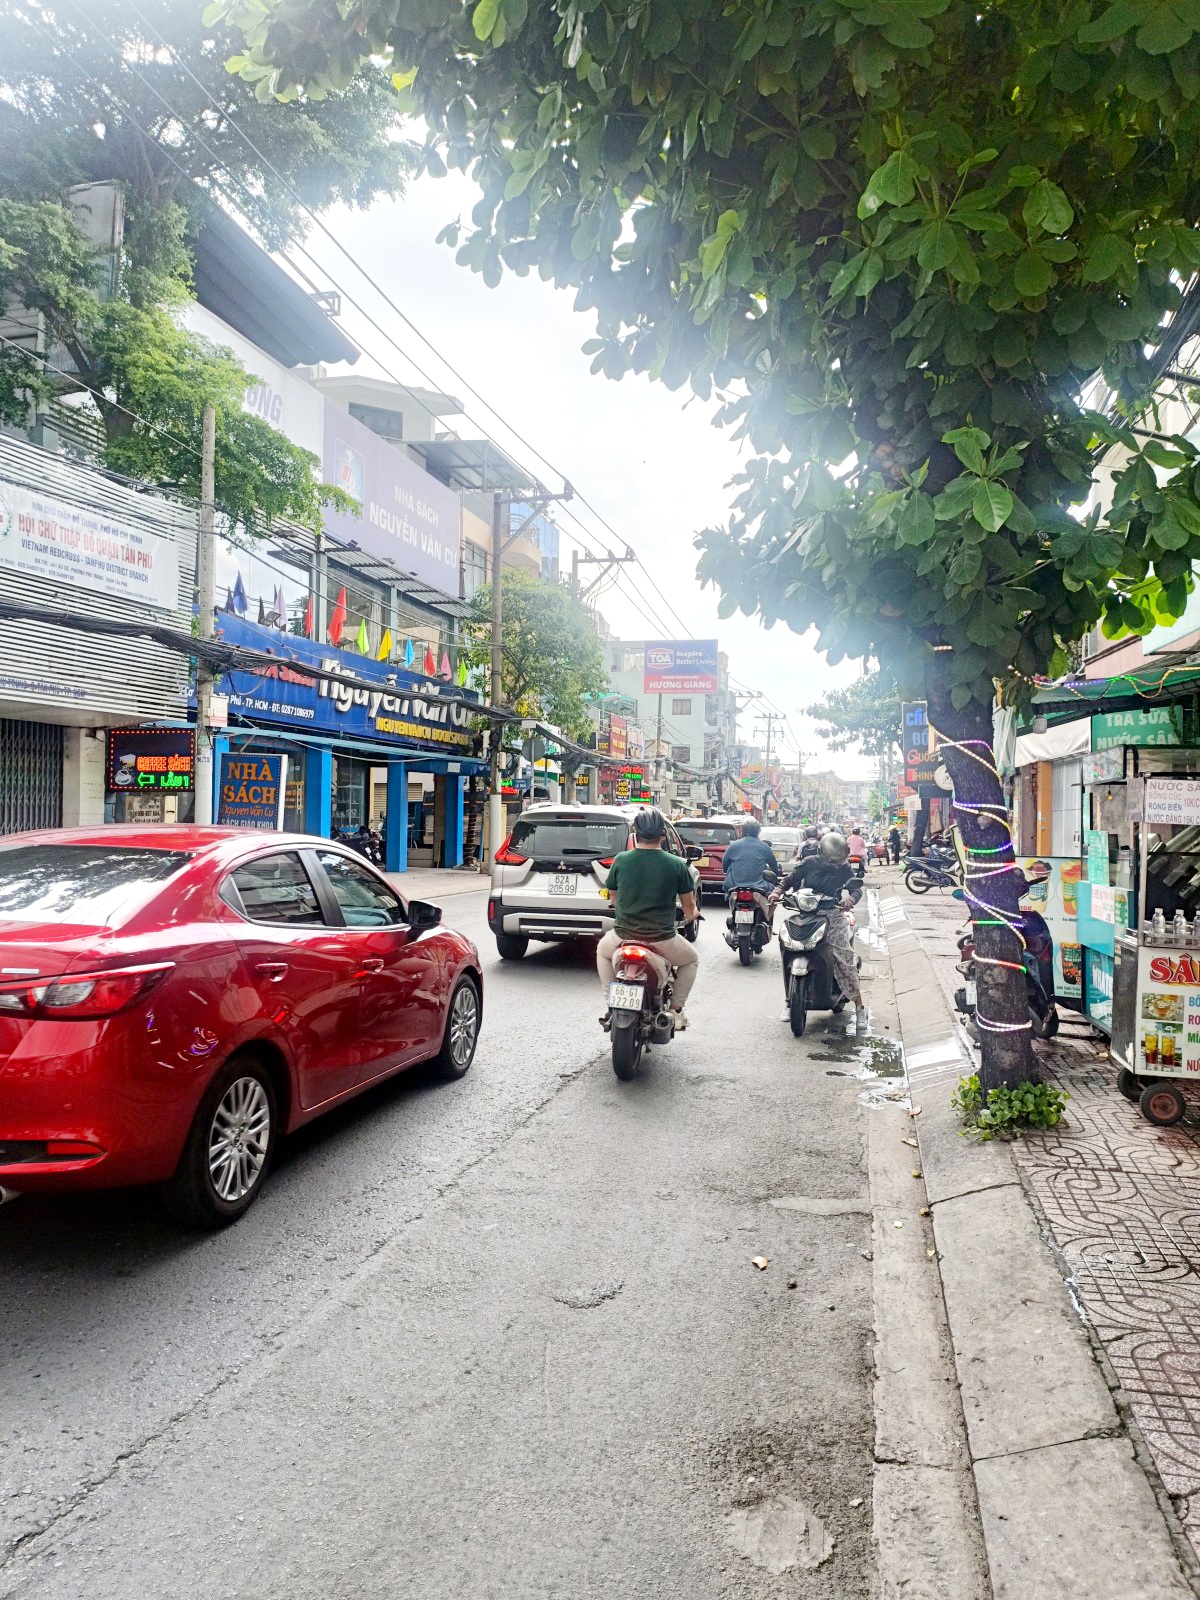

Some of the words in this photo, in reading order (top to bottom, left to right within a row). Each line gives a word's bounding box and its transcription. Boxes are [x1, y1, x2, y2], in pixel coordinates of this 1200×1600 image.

[394, 485, 414, 511] NHÀ
[416, 499, 439, 527] SÁCH
[369, 501, 417, 547] NGUYỄN
[420, 531, 442, 560] VĂN
[19, 512, 35, 536] HỘI
[38, 519, 57, 541] CHỮ
[59, 525, 81, 549] THẬP
[83, 530, 94, 553] ĐỎ
[96, 537, 119, 560] QUẬN
[121, 543, 135, 565] TÂN
[137, 550, 152, 570] PHÚ
[21, 538, 48, 554] VIETNAM
[49, 546, 80, 563] REDCROSS
[85, 556, 105, 570] TANPHU
[106, 562, 128, 577] DISTRICT
[129, 569, 149, 583] BRANCH
[649, 654, 672, 663] TOA
[649, 680, 682, 689] HƯƠNG
[683, 681, 712, 689] GIANG
[230, 694, 242, 706] Phú
[255, 699, 269, 711] HCM
[137, 756, 167, 771] COFFEE
[168, 753, 191, 771] SÁCH
[228, 758, 274, 781] NHÀ
[223, 780, 276, 804] SÁCH
[1149, 781, 1183, 792] NƯỚC
[555, 875, 570, 884] 62A
[549, 884, 575, 894] 205.99
[1149, 952, 1200, 985] SÂ
[615, 985, 638, 998] 66-G1
[610, 996, 641, 1009] 322.09
